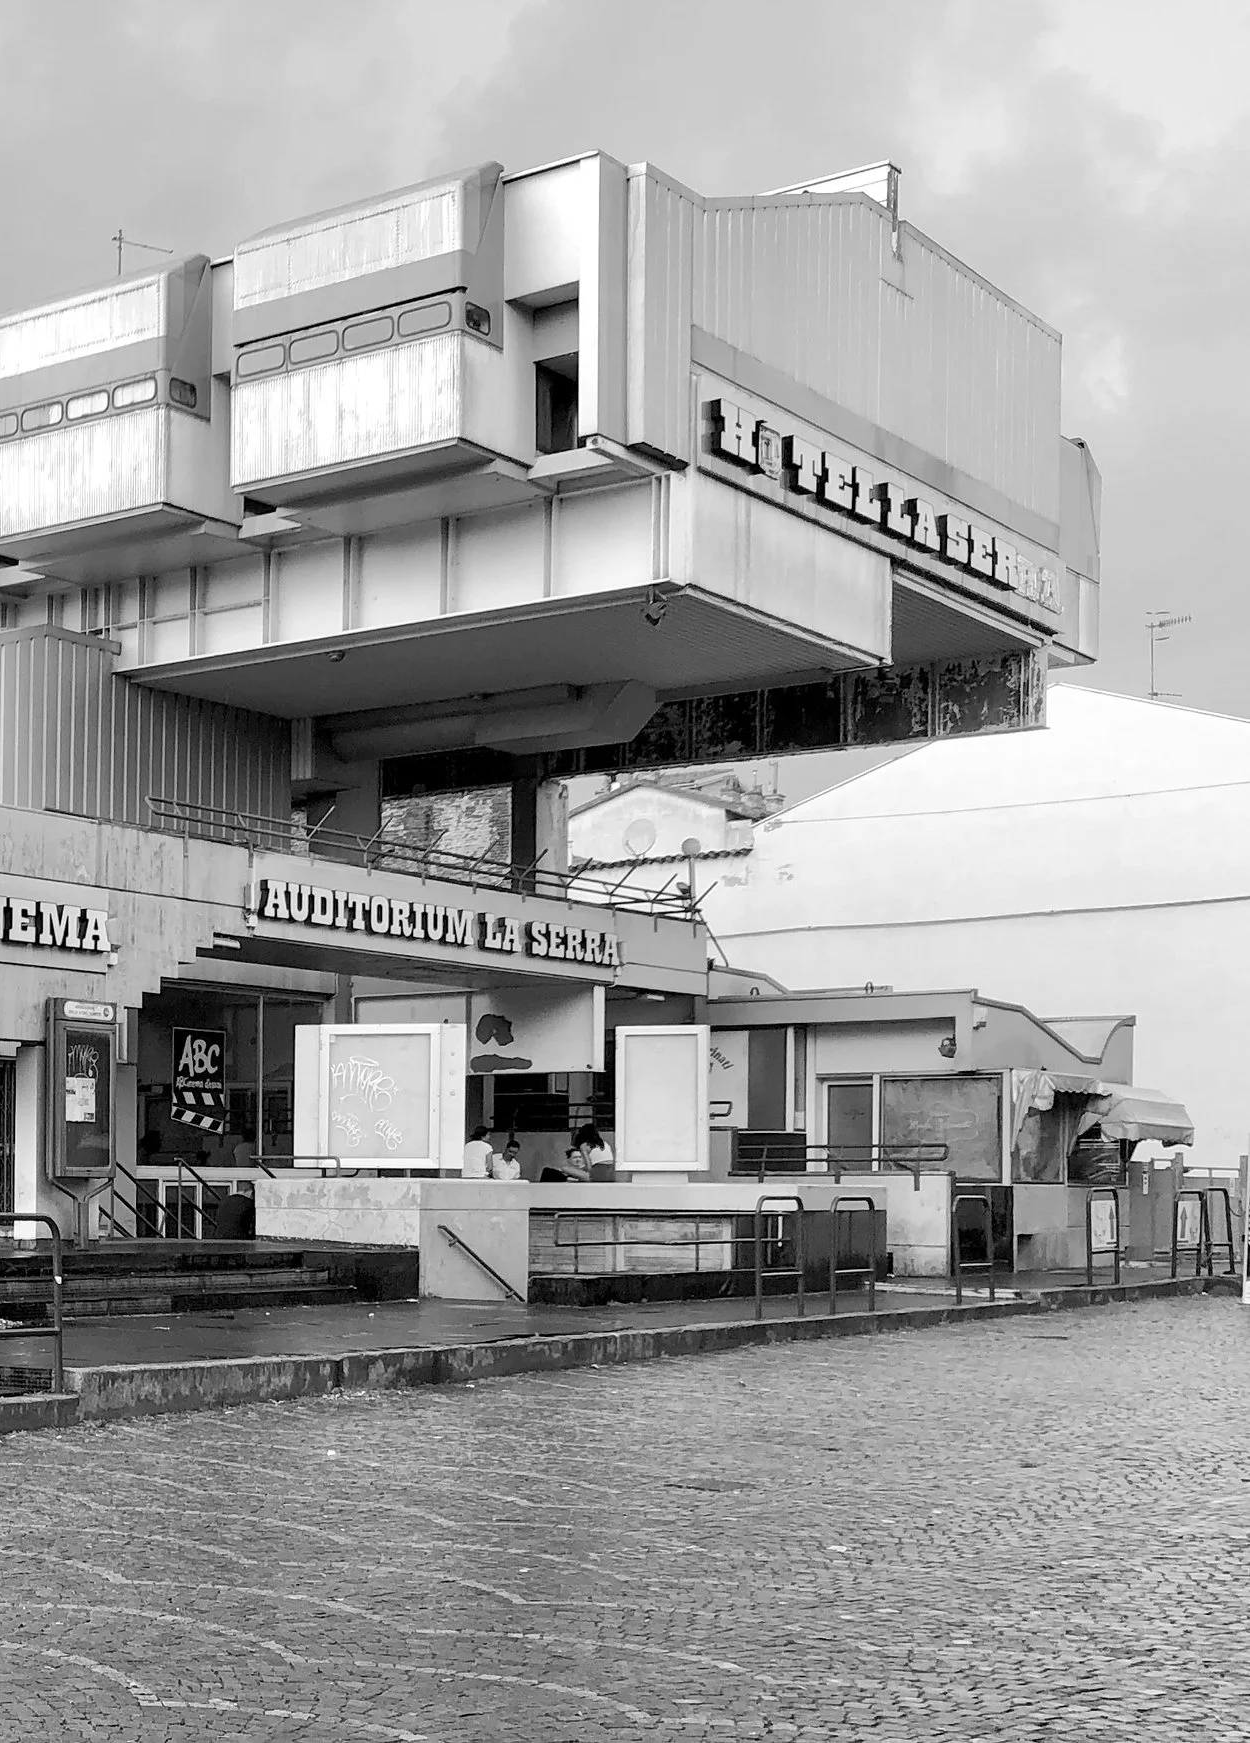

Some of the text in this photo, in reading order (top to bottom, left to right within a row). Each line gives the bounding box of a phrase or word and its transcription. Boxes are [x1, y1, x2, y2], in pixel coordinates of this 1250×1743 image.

[712, 398, 881, 525] HOTEL
[882, 481, 941, 554] LA
[261, 879, 621, 967] AUDITORIUM LA SERRA
[178, 1034, 220, 1078] ABC
